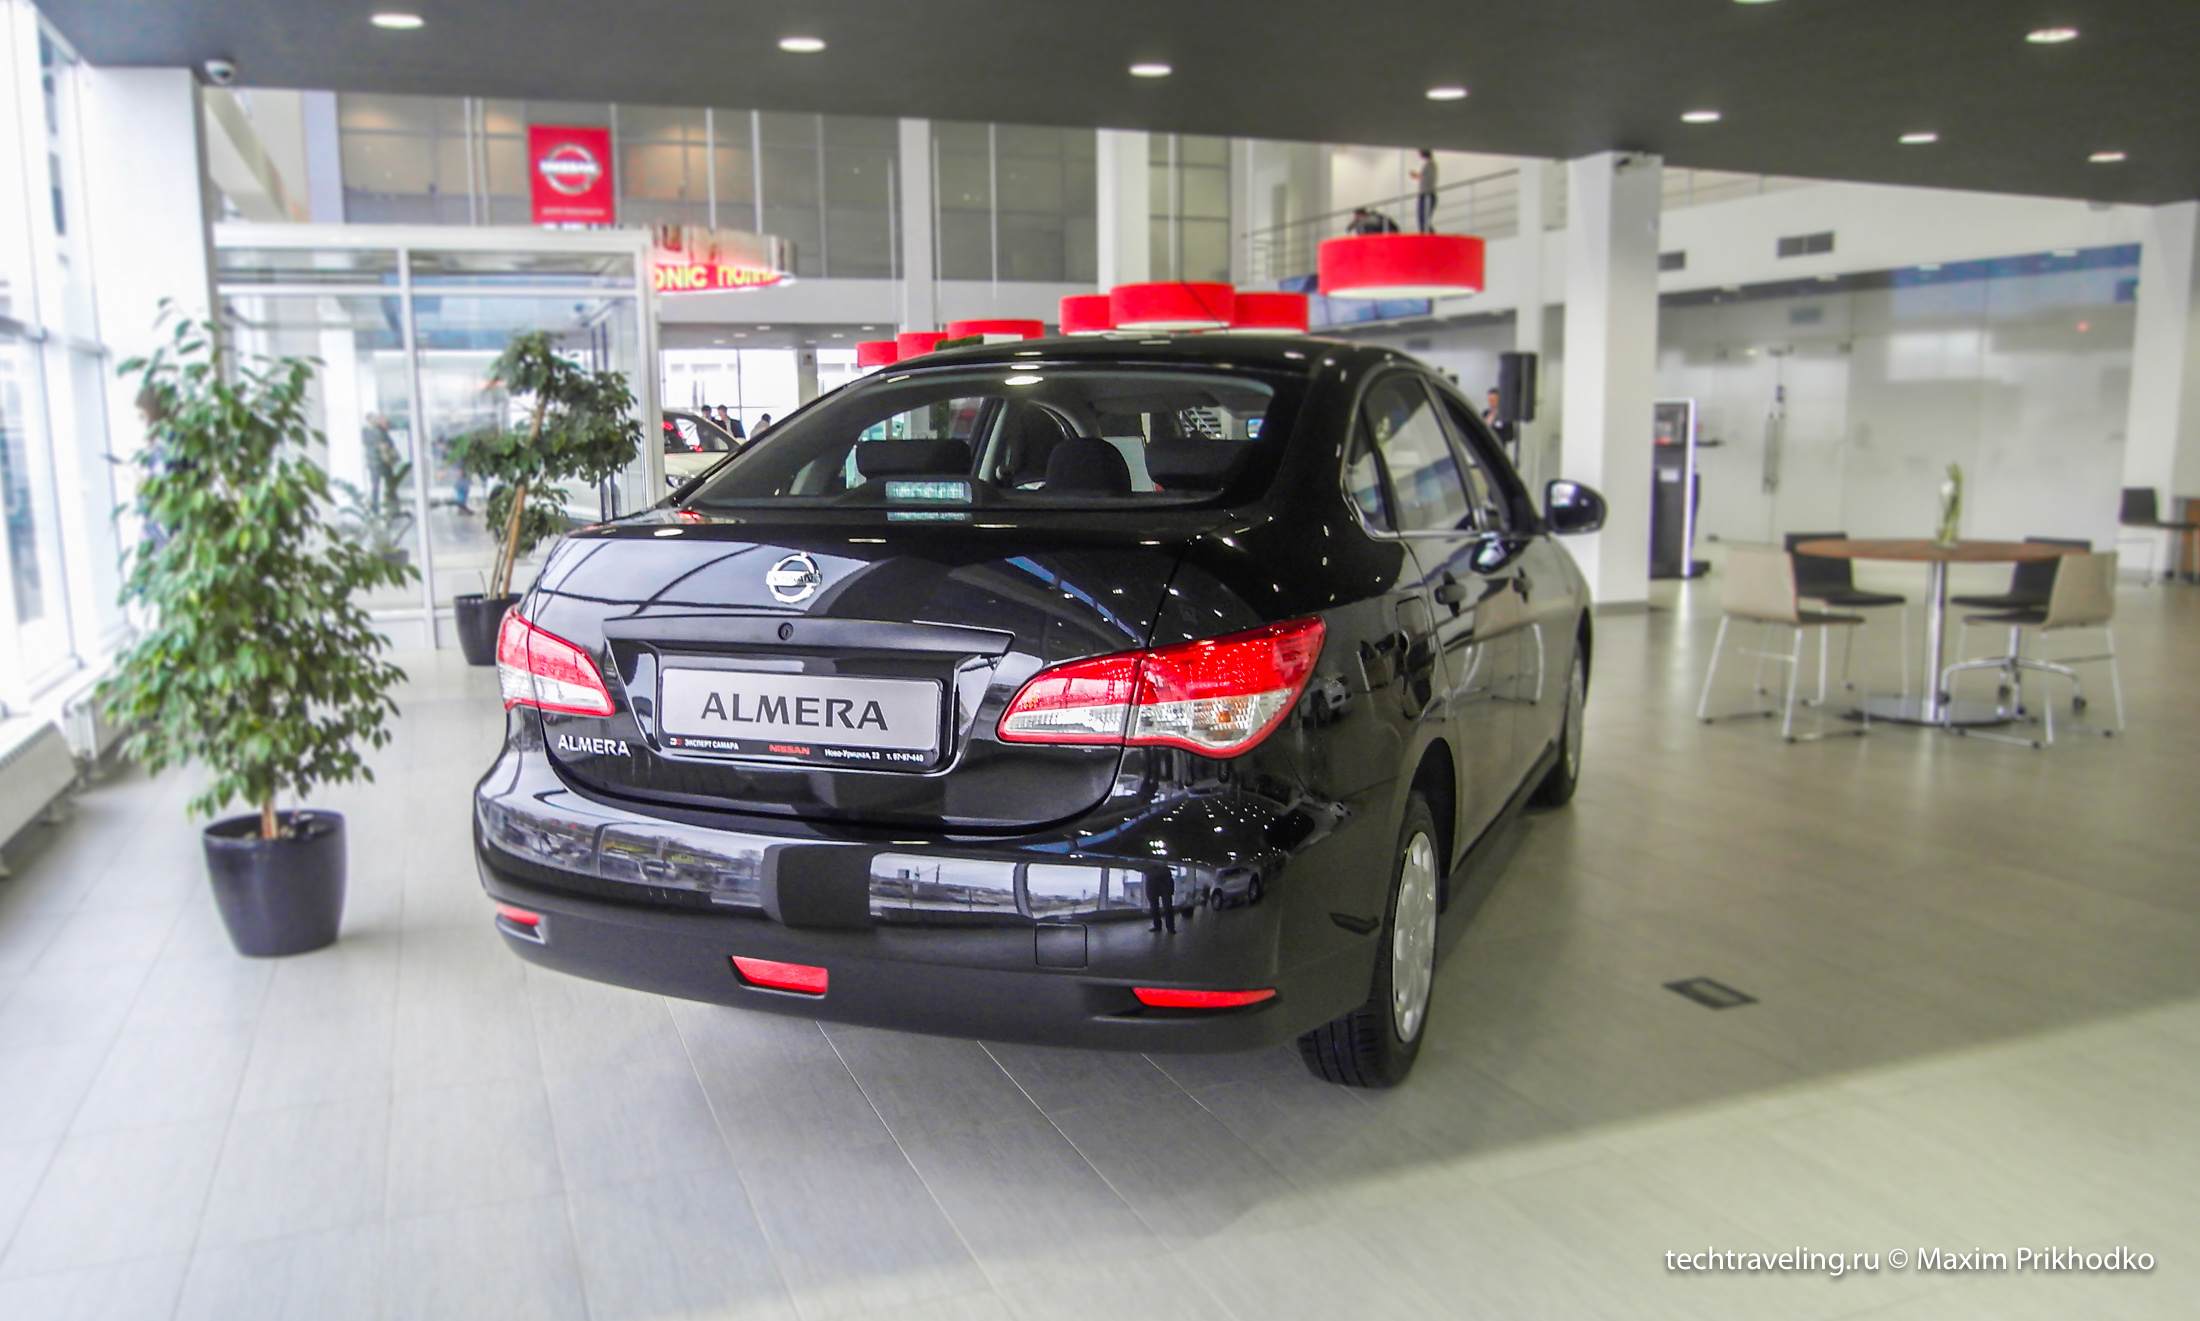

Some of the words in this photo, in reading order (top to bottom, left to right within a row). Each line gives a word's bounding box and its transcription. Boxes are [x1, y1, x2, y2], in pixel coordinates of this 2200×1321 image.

[701, 692, 888, 731] ALMERA
[558, 734, 631, 757] ALMERA
[684, 738, 712, 748] ЭКСПЕРТ
[712, 740, 739, 751] САМАРА
[768, 743, 810, 755] NISSAN
